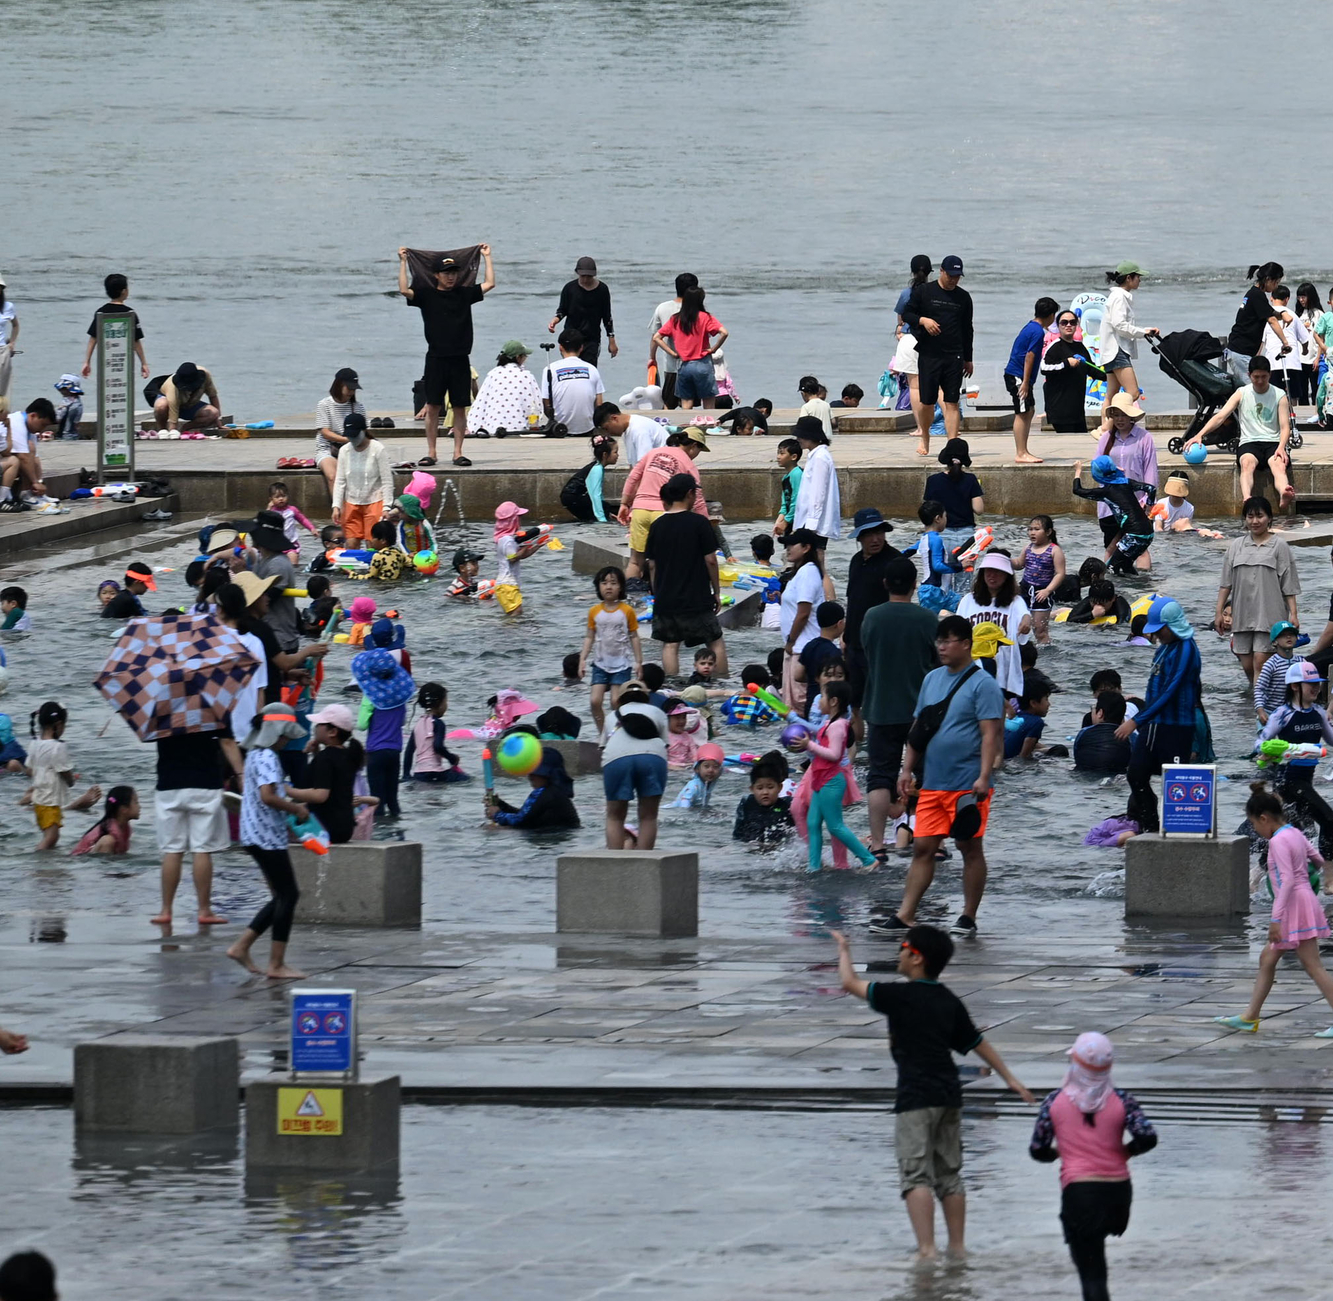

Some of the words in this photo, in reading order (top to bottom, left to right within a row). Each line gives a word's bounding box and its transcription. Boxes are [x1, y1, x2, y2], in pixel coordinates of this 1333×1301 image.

[557, 372, 590, 382] patagonia
[1294, 723, 1322, 733] BARREL
[282, 1119, 311, 1132] 미끄럼
